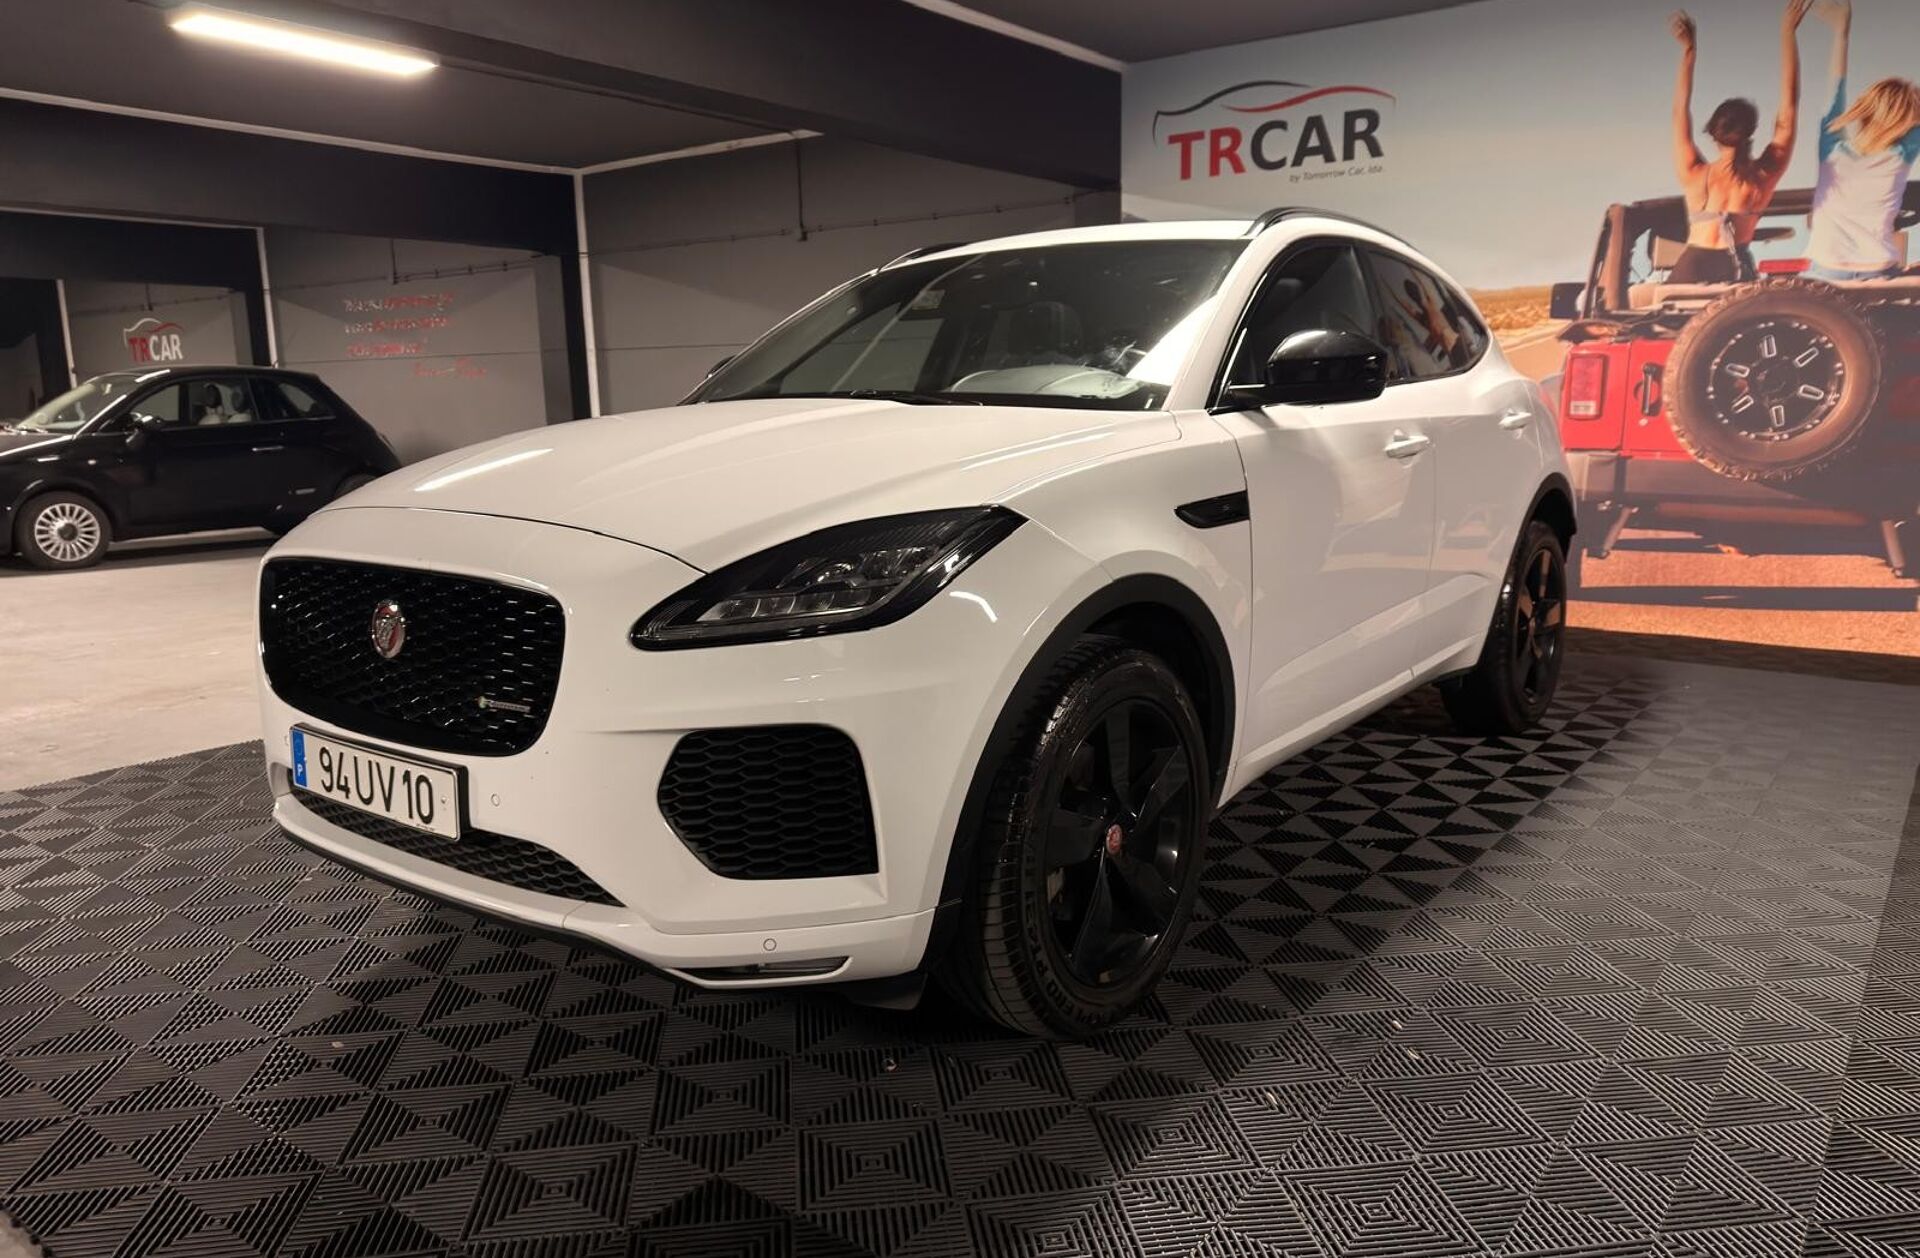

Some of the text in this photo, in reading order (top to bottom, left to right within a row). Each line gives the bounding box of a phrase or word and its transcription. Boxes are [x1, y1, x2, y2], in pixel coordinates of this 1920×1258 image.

[1167, 108, 1384, 181] TRCAR
[1289, 174, 1301, 184] by
[1303, 170, 1345, 181] Tomorrow
[128, 334, 184, 362] TRCAR
[297, 763, 303, 777] P
